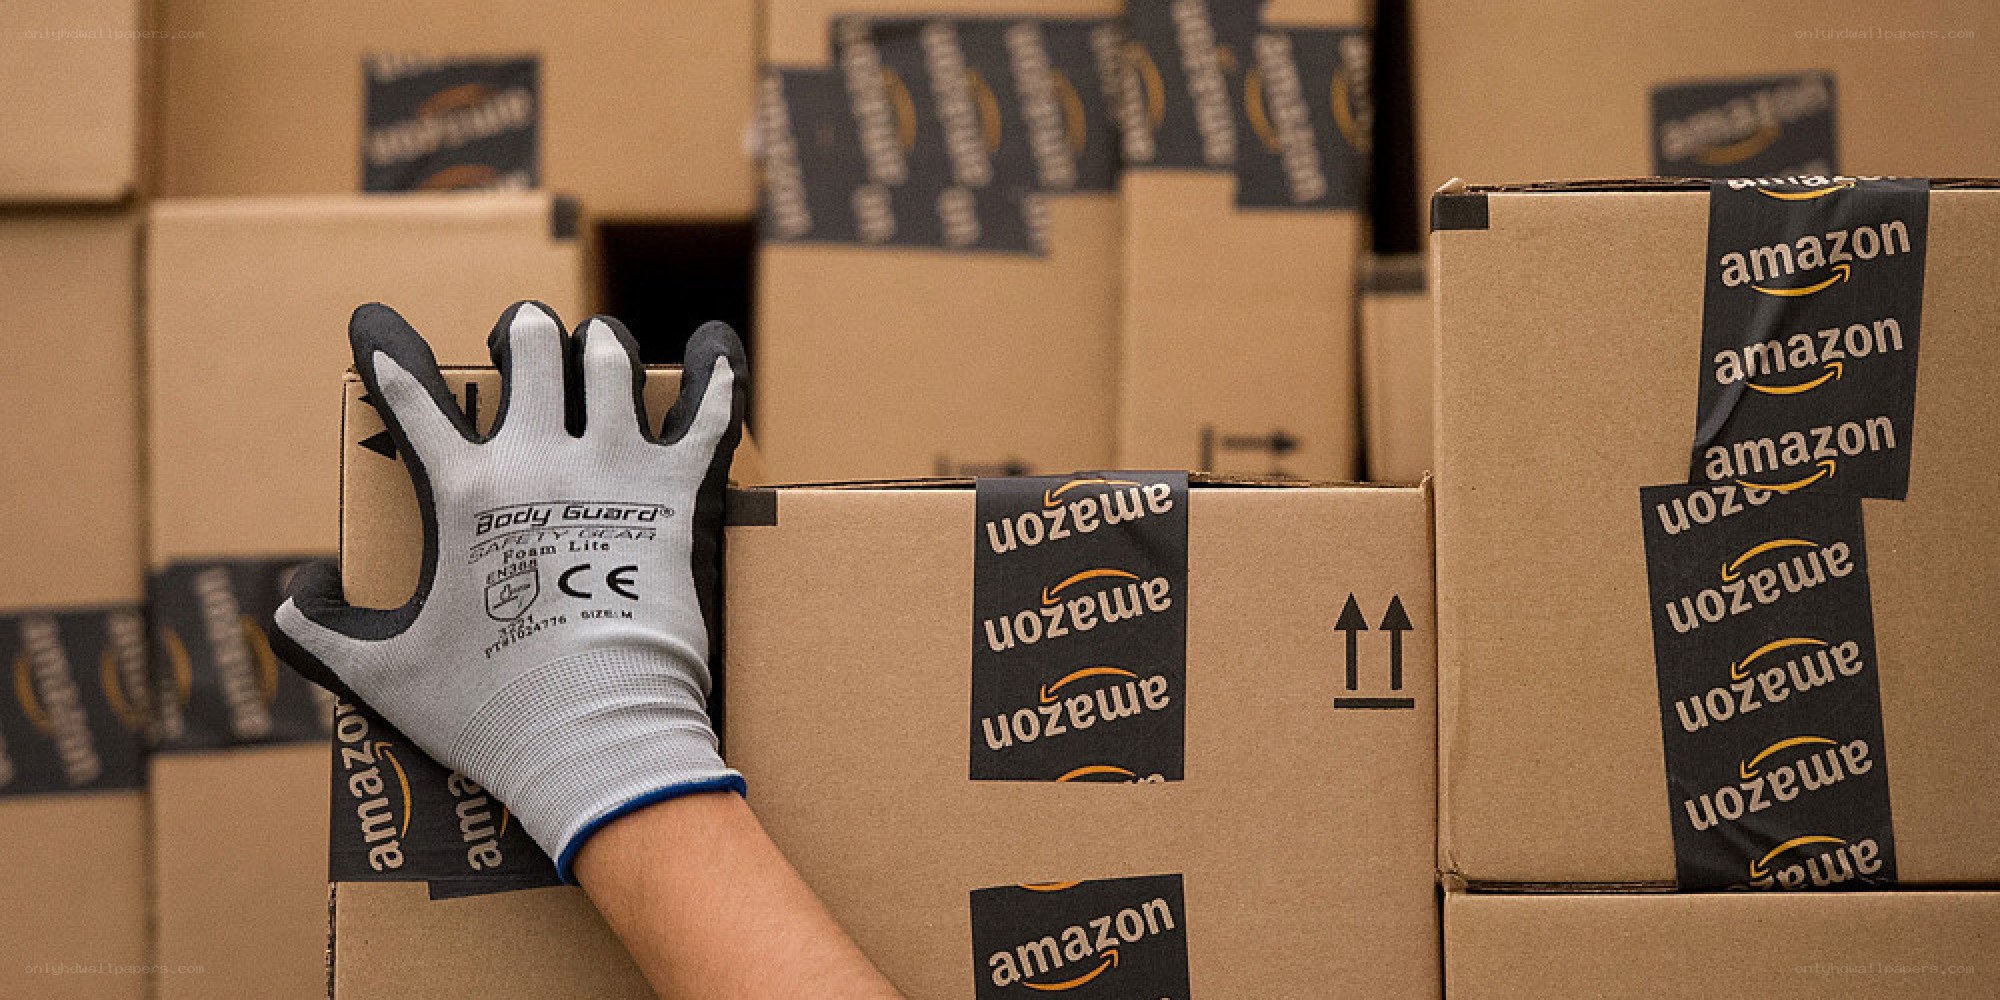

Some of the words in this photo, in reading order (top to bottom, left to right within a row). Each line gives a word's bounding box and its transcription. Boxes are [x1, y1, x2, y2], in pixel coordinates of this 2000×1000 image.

[1720, 220, 1911, 287] amazon
[1714, 317, 1903, 385] amazon
[1705, 415, 1896, 480] amazon
[476, 507, 552, 535] Body
[503, 545, 557, 564] Foam
[569, 540, 610, 552] Lite
[986, 483, 1173, 553] amazon
[984, 577, 1173, 652] amazon
[1666, 541, 1854, 633] amazon
[982, 675, 1170, 750] amazon
[1675, 641, 1863, 732] amazon
[448, 772, 503, 871] ama
[1684, 739, 1872, 831] amazon
[989, 897, 1175, 987] amazon
